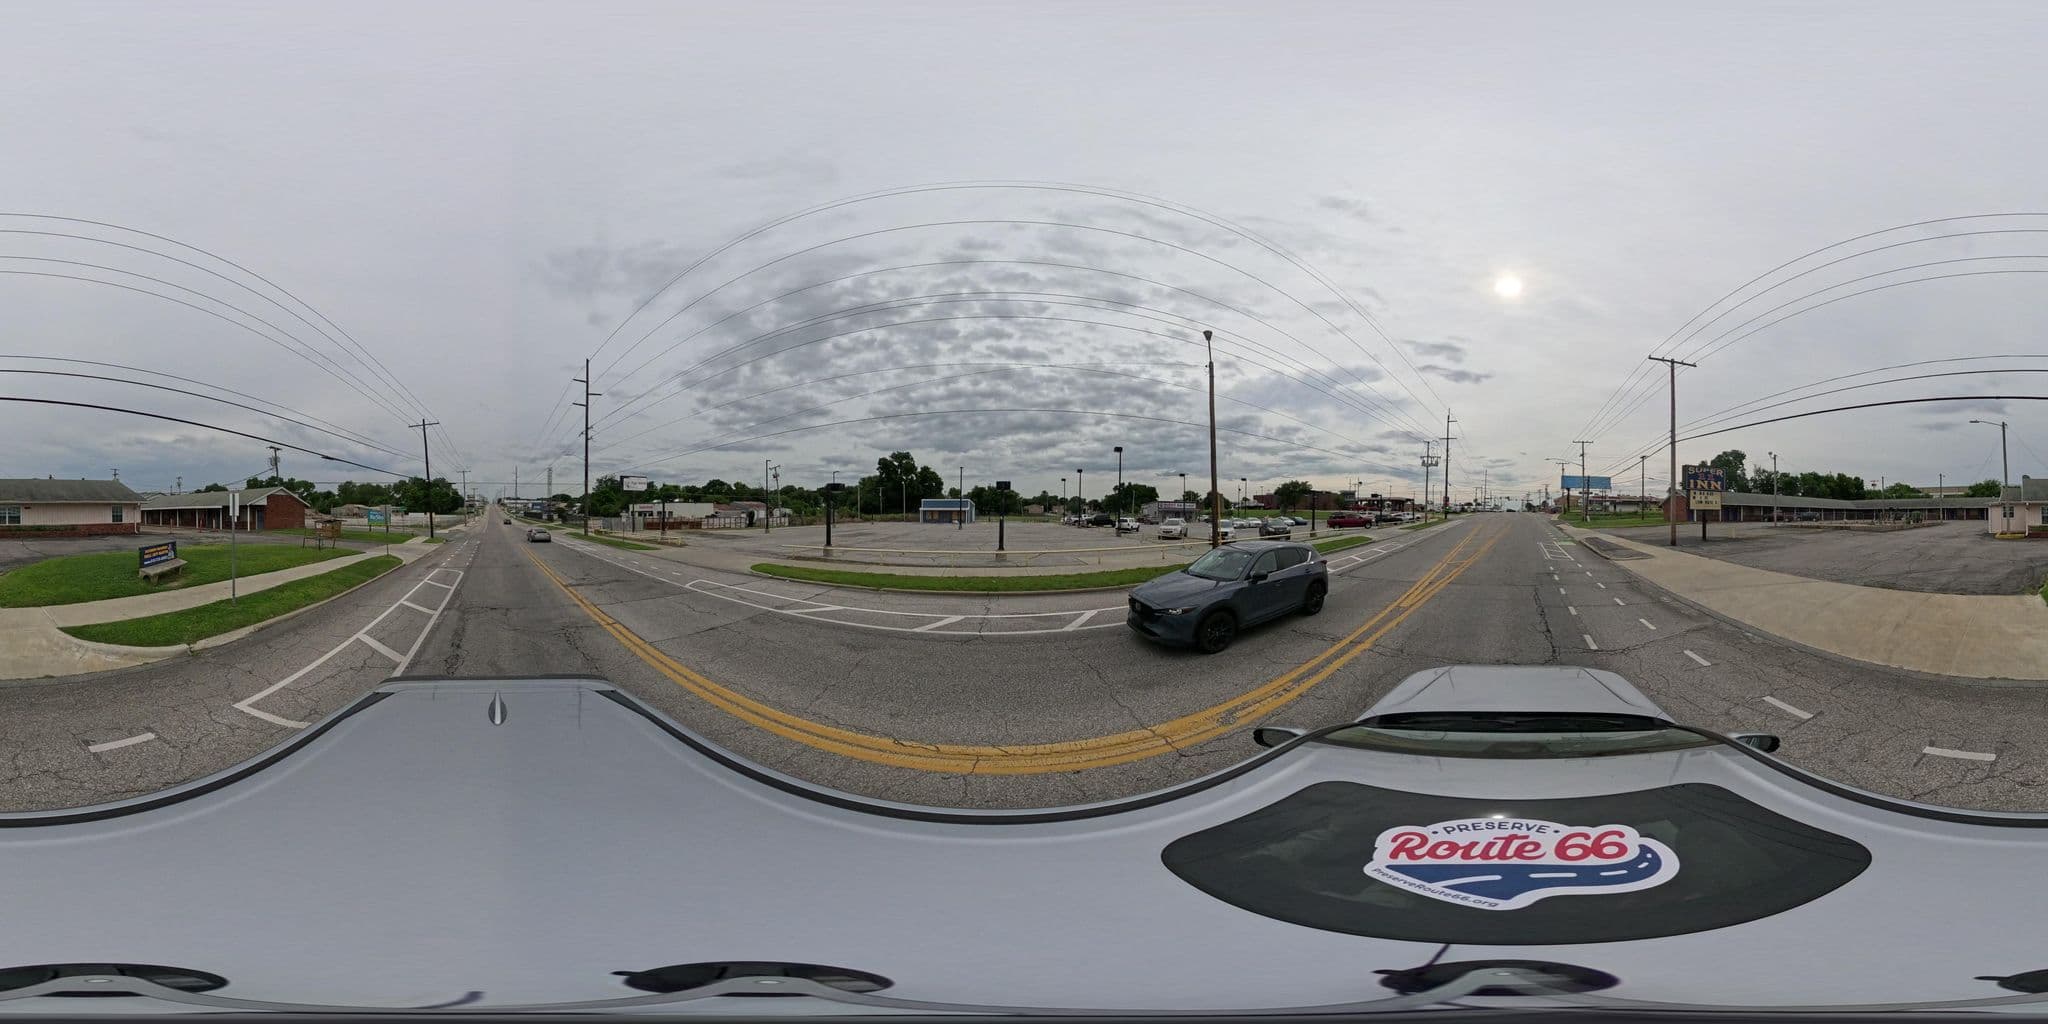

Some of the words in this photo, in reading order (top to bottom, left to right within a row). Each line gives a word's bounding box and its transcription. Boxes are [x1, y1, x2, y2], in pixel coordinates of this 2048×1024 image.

[1688, 466, 1724, 478] SUPER
[1690, 479, 1722, 490] INN
[1443, 821, 1550, 835] PRESERVE
[1388, 831, 1547, 861] Route
[1554, 830, 1629, 861] 66
[1371, 867, 1500, 908] PreserveRoute66.org
